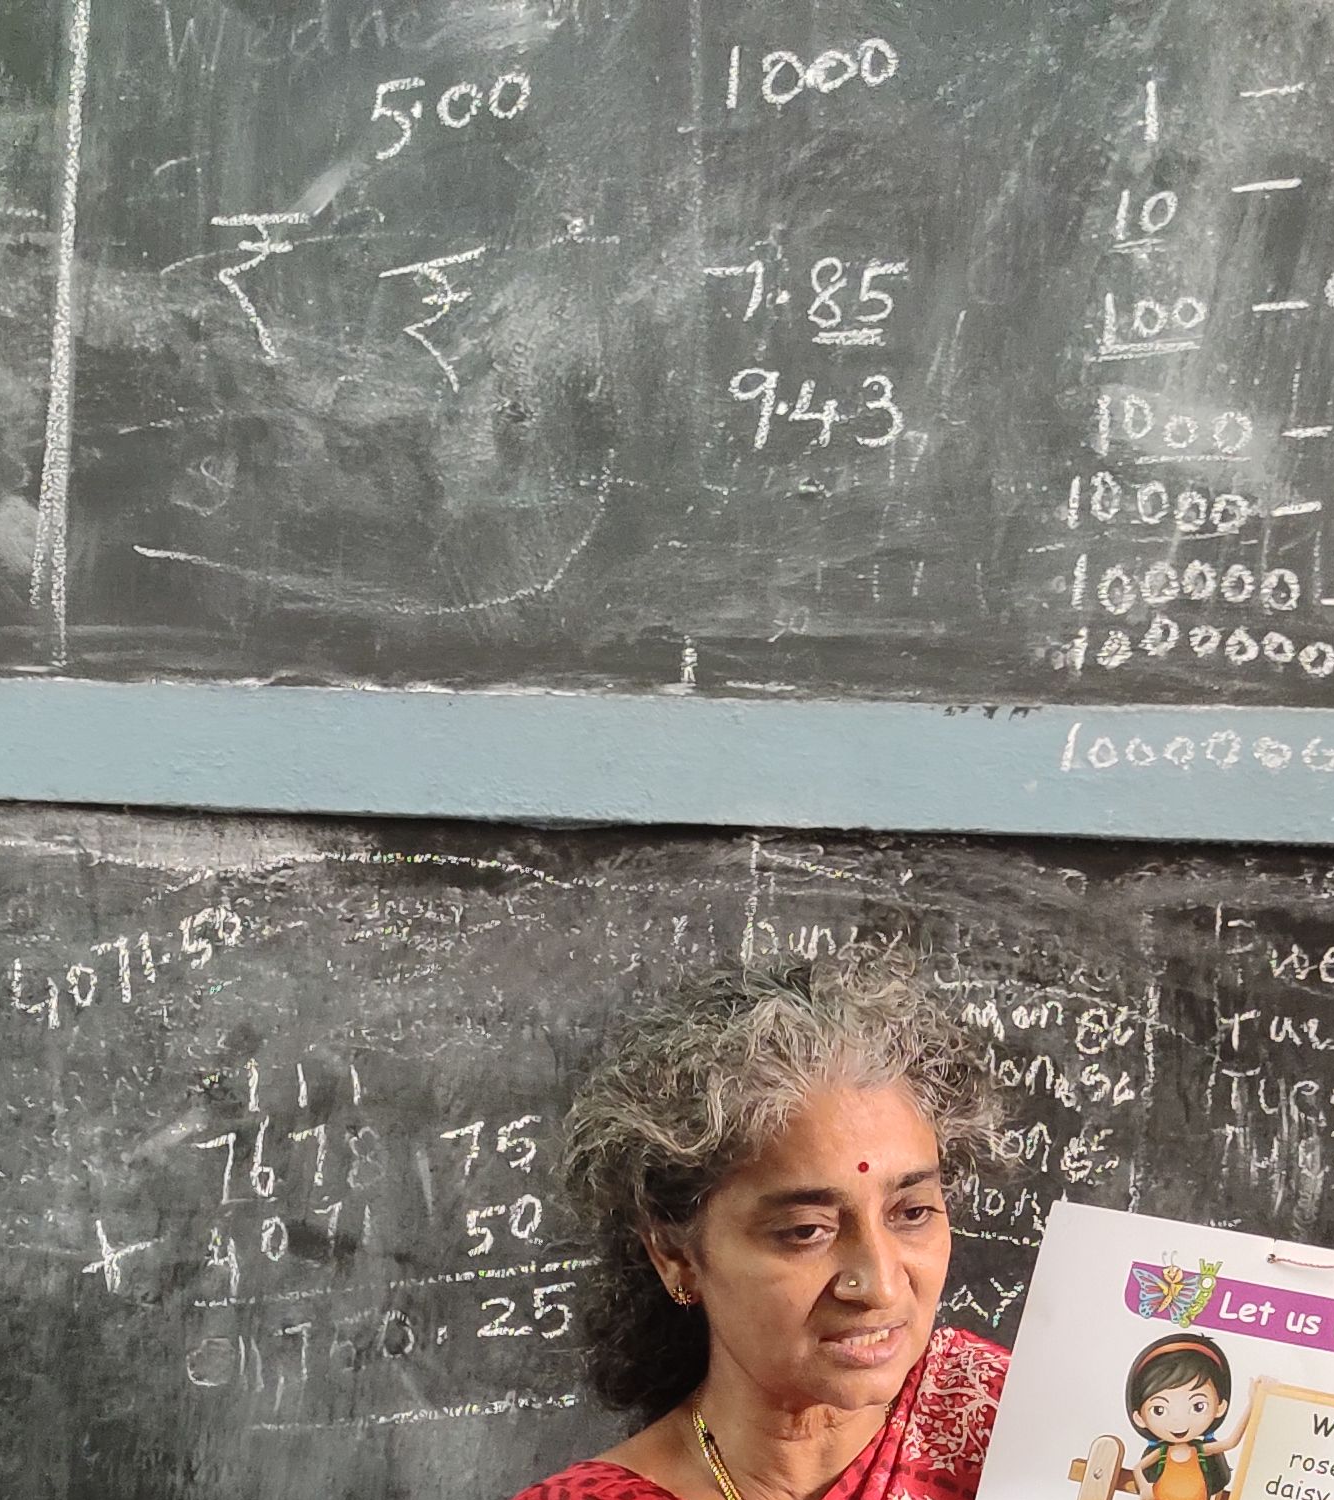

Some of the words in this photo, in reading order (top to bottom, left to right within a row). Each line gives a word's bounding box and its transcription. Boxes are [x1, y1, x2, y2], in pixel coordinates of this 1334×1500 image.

[726, 37, 900, 108] 1000
[1144, 80, 1159, 143] 1
[1115, 189, 1177, 242] 10
[1099, 292, 1209, 350] 100
[1095, 394, 1253, 457] 1000
[1218, 1291, 1276, 1326] Let
[1285, 1311, 1323, 1335] us
